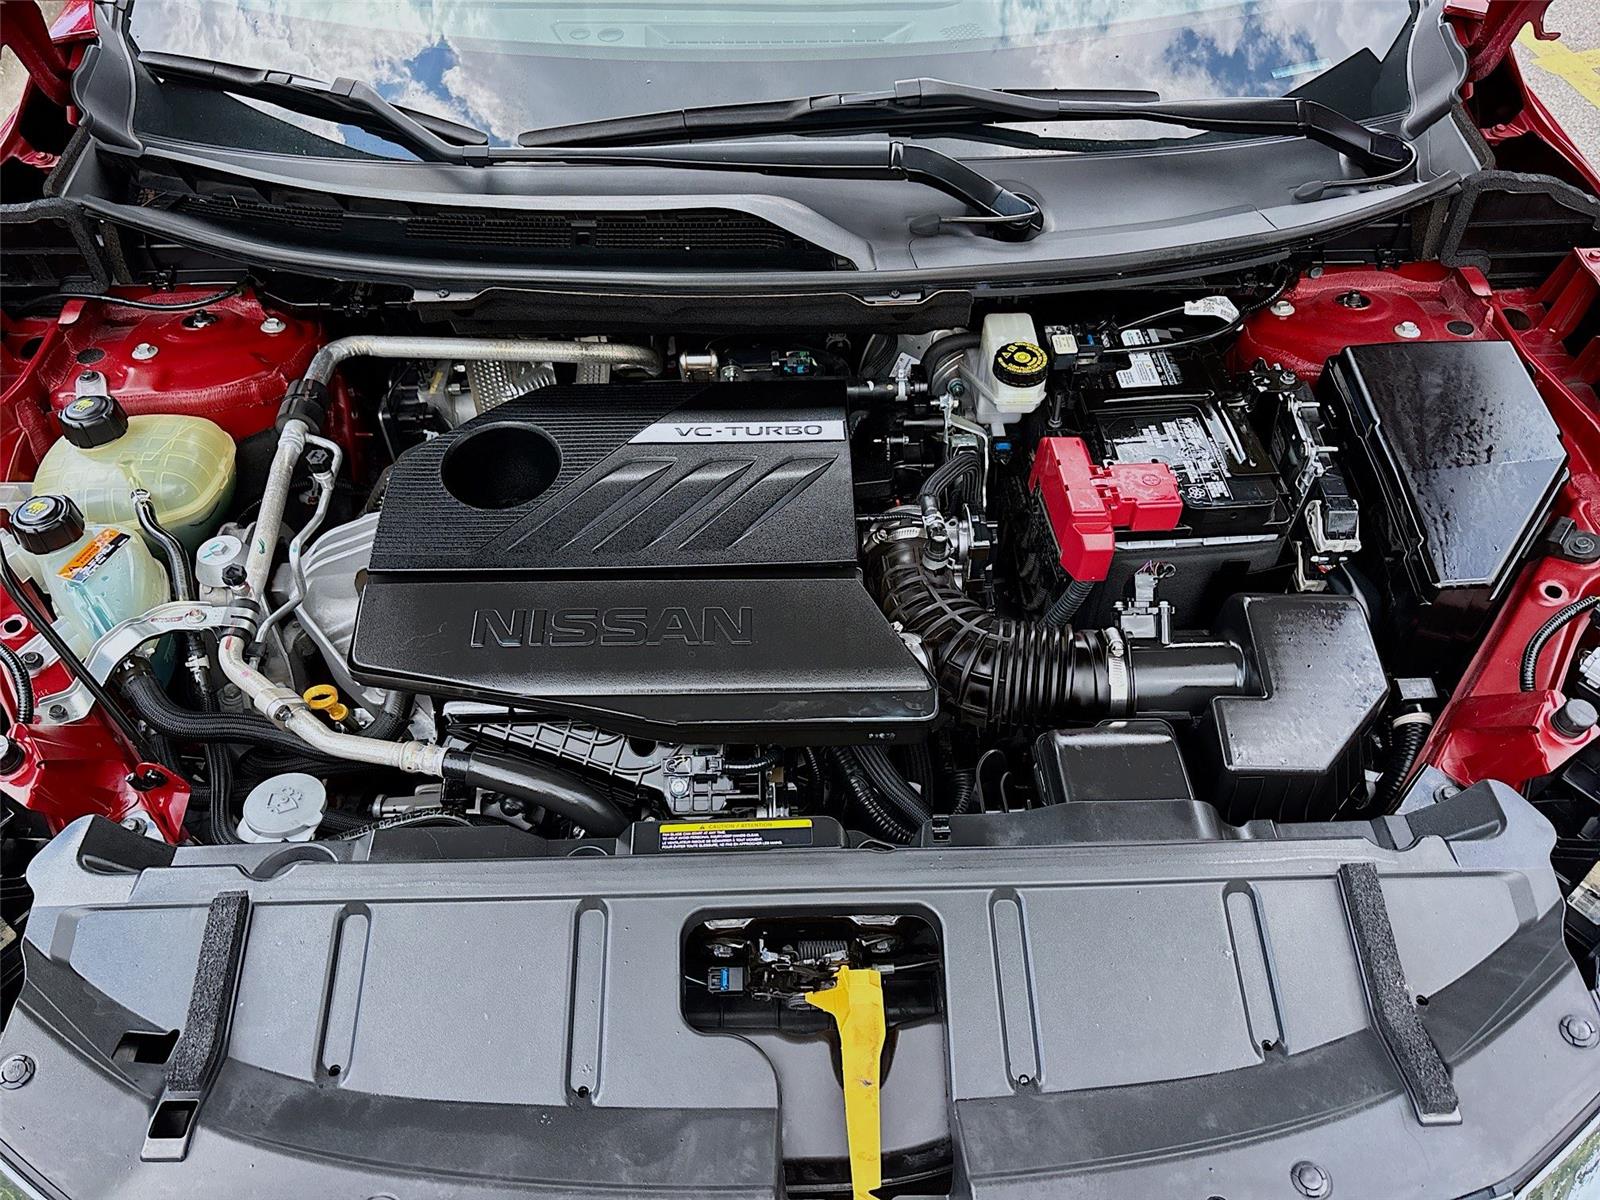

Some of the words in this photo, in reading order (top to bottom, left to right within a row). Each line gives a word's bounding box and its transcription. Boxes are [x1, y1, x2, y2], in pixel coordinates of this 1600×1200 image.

[674, 424, 823, 437] VC-TURBO
[470, 606, 753, 648] NISSAN
[708, 822, 736, 830] CAUTION
[741, 821, 773, 829] ATTENTION
